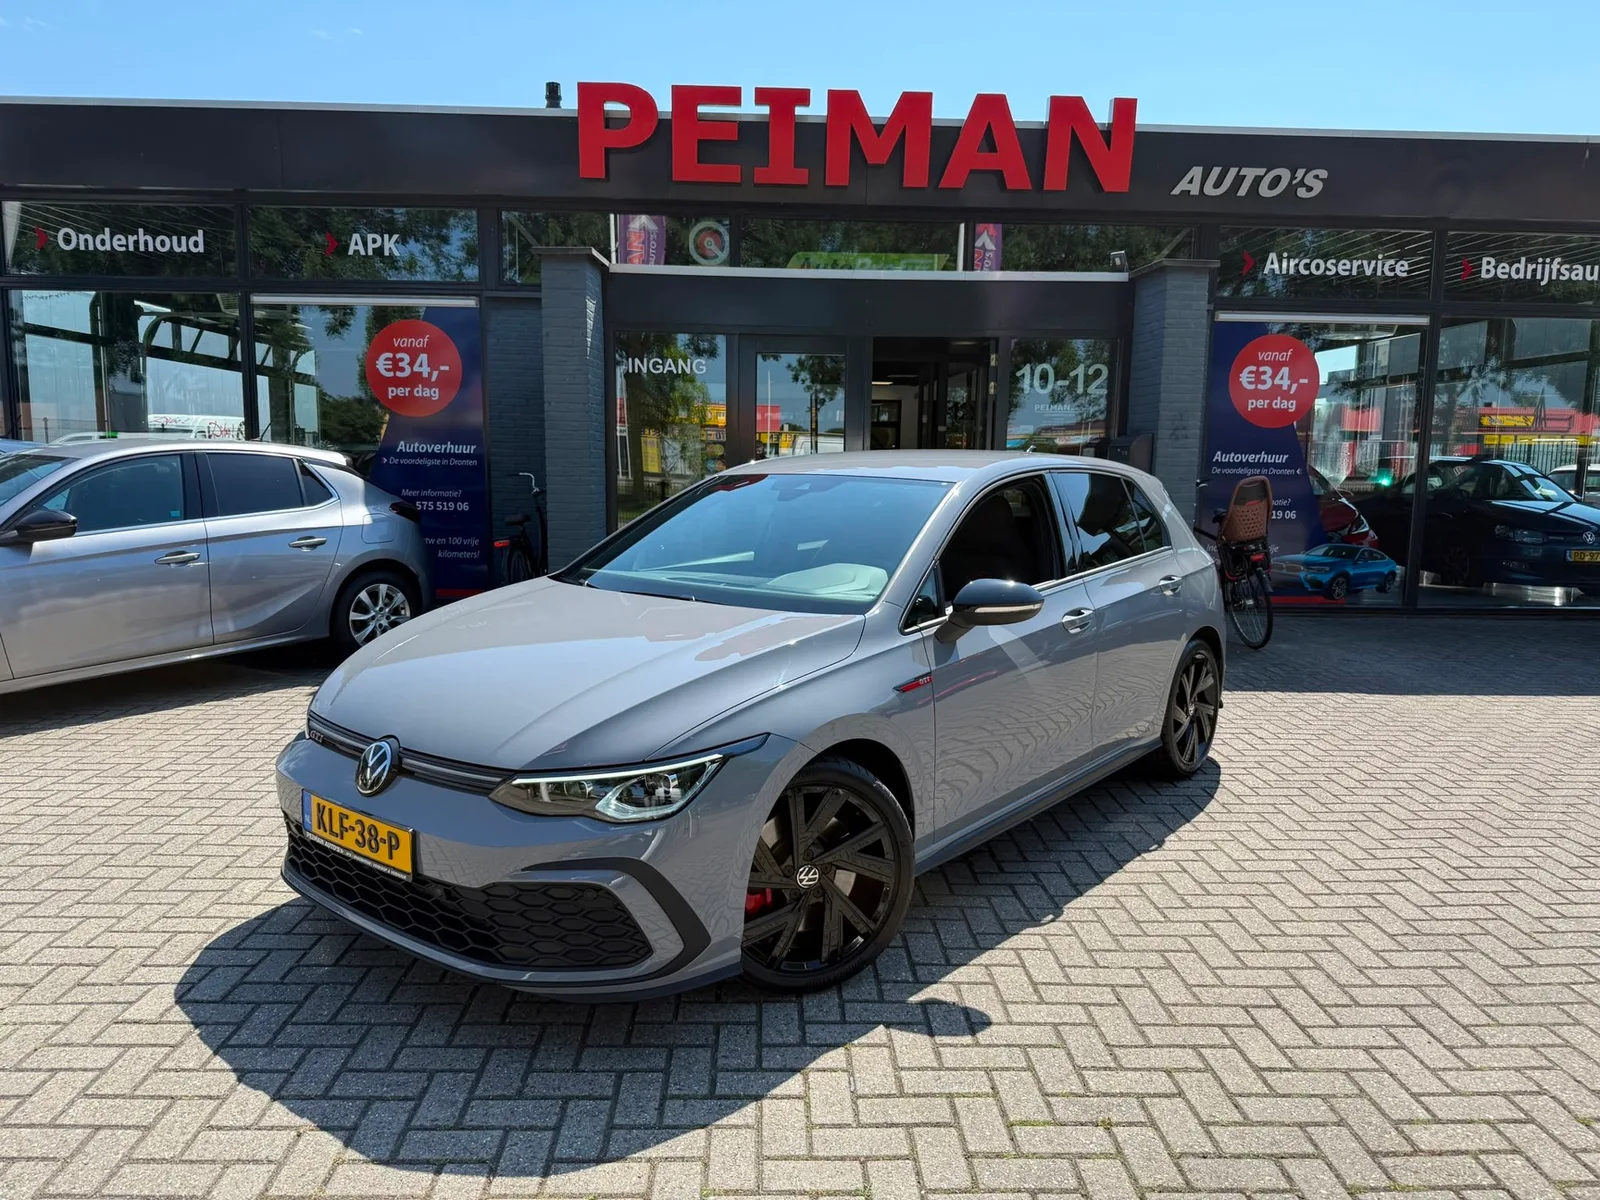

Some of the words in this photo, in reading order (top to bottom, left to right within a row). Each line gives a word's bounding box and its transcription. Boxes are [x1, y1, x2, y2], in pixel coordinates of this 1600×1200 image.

[577, 82, 1138, 193] PEIMAN
[1170, 166, 1329, 199] AUTO'S
[57, 227, 205, 254] Onderhoud
[348, 233, 401, 257] APK
[1263, 252, 1410, 278] Aircoservice
[1480, 256, 1600, 286] Bedrijfsau
[393, 335, 430, 348] vanaf
[1258, 348, 1294, 361] vanaf
[376, 352, 450, 382] €34,-
[628, 357, 707, 375] INGANG
[1016, 363, 1109, 395] 10-12
[1239, 365, 1309, 394] €34,-
[388, 387, 411, 399] per
[414, 384, 440, 400] dag
[1034, 404, 1071, 412] PEIMAN
[1248, 399, 1270, 411] per
[1272, 396, 1297, 412] dag
[396, 441, 477, 454] Autoverhuur
[389, 457, 399, 465] De
[400, 457, 441, 467] voordeligste
[442, 458, 449, 466] in
[449, 458, 478, 466] Dronten
[1212, 450, 1289, 463] Autoverhuur
[1211, 466, 1221, 474] De
[1221, 466, 1260, 475] voordeligste
[1261, 466, 1268, 474] in
[1268, 466, 1295, 475] Dronten
[401, 488, 419, 497] Meer
[420, 488, 462, 498] informatie?
[415, 501, 434, 511] 575
[436, 501, 455, 511] 519
[456, 502, 469, 511] 06
[1284, 510, 1297, 519] 06
[424, 537, 436, 545] tw
[449, 537, 463, 545] 100
[463, 537, 480, 548] vrije
[437, 549, 481, 559] kilometers!
[309, 730, 325, 743] GTI
[316, 802, 401, 861] KLF-38-P
